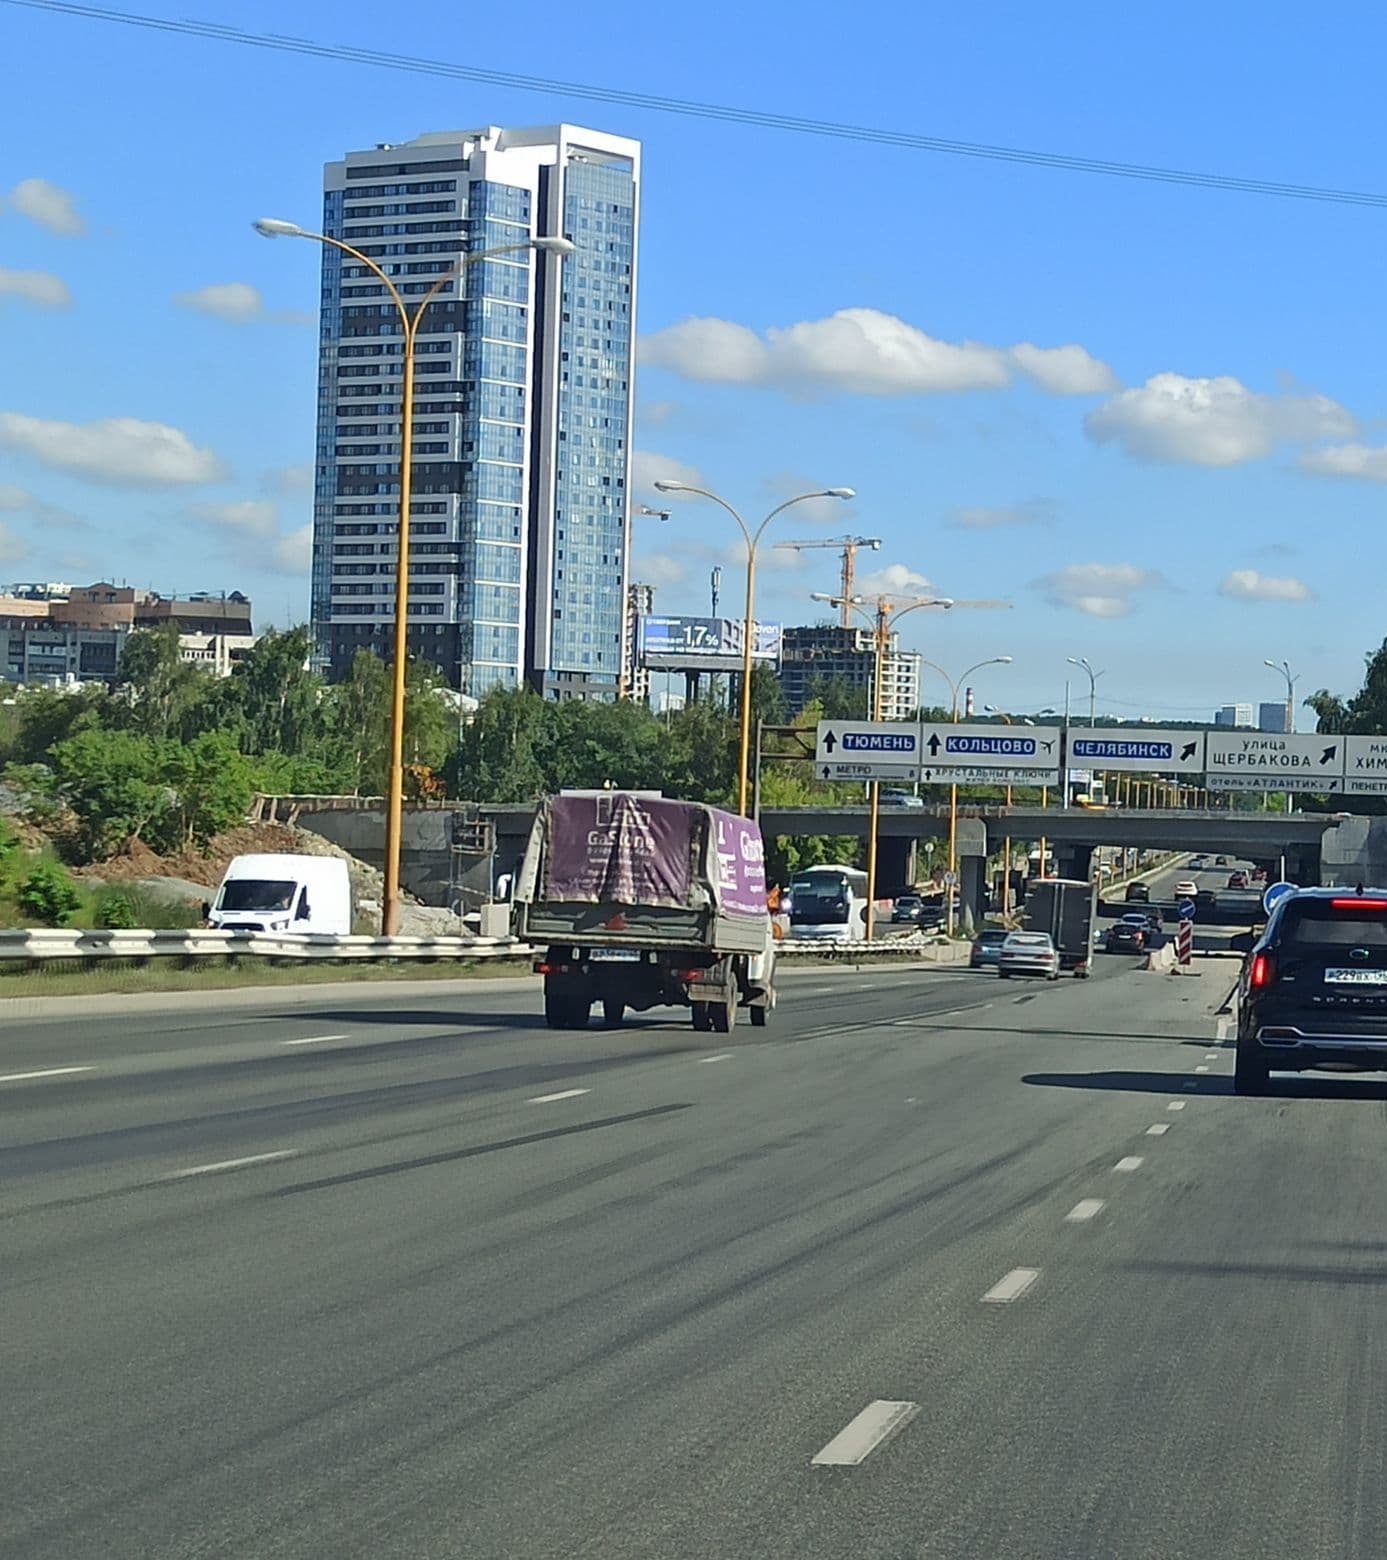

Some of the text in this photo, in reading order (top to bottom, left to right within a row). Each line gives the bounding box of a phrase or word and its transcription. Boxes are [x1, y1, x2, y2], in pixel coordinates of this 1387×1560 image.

[845, 735, 914, 750] ТЮМЕНЬ
[947, 738, 1034, 753] КОЛЬЦОВО
[1075, 742, 1170, 757] ЧЕЛЯБИНСК
[1242, 740, 1287, 751] улица
[1213, 753, 1312, 767] ЩЕРБАКОВА
[836, 765, 872, 776] МЕТРО
